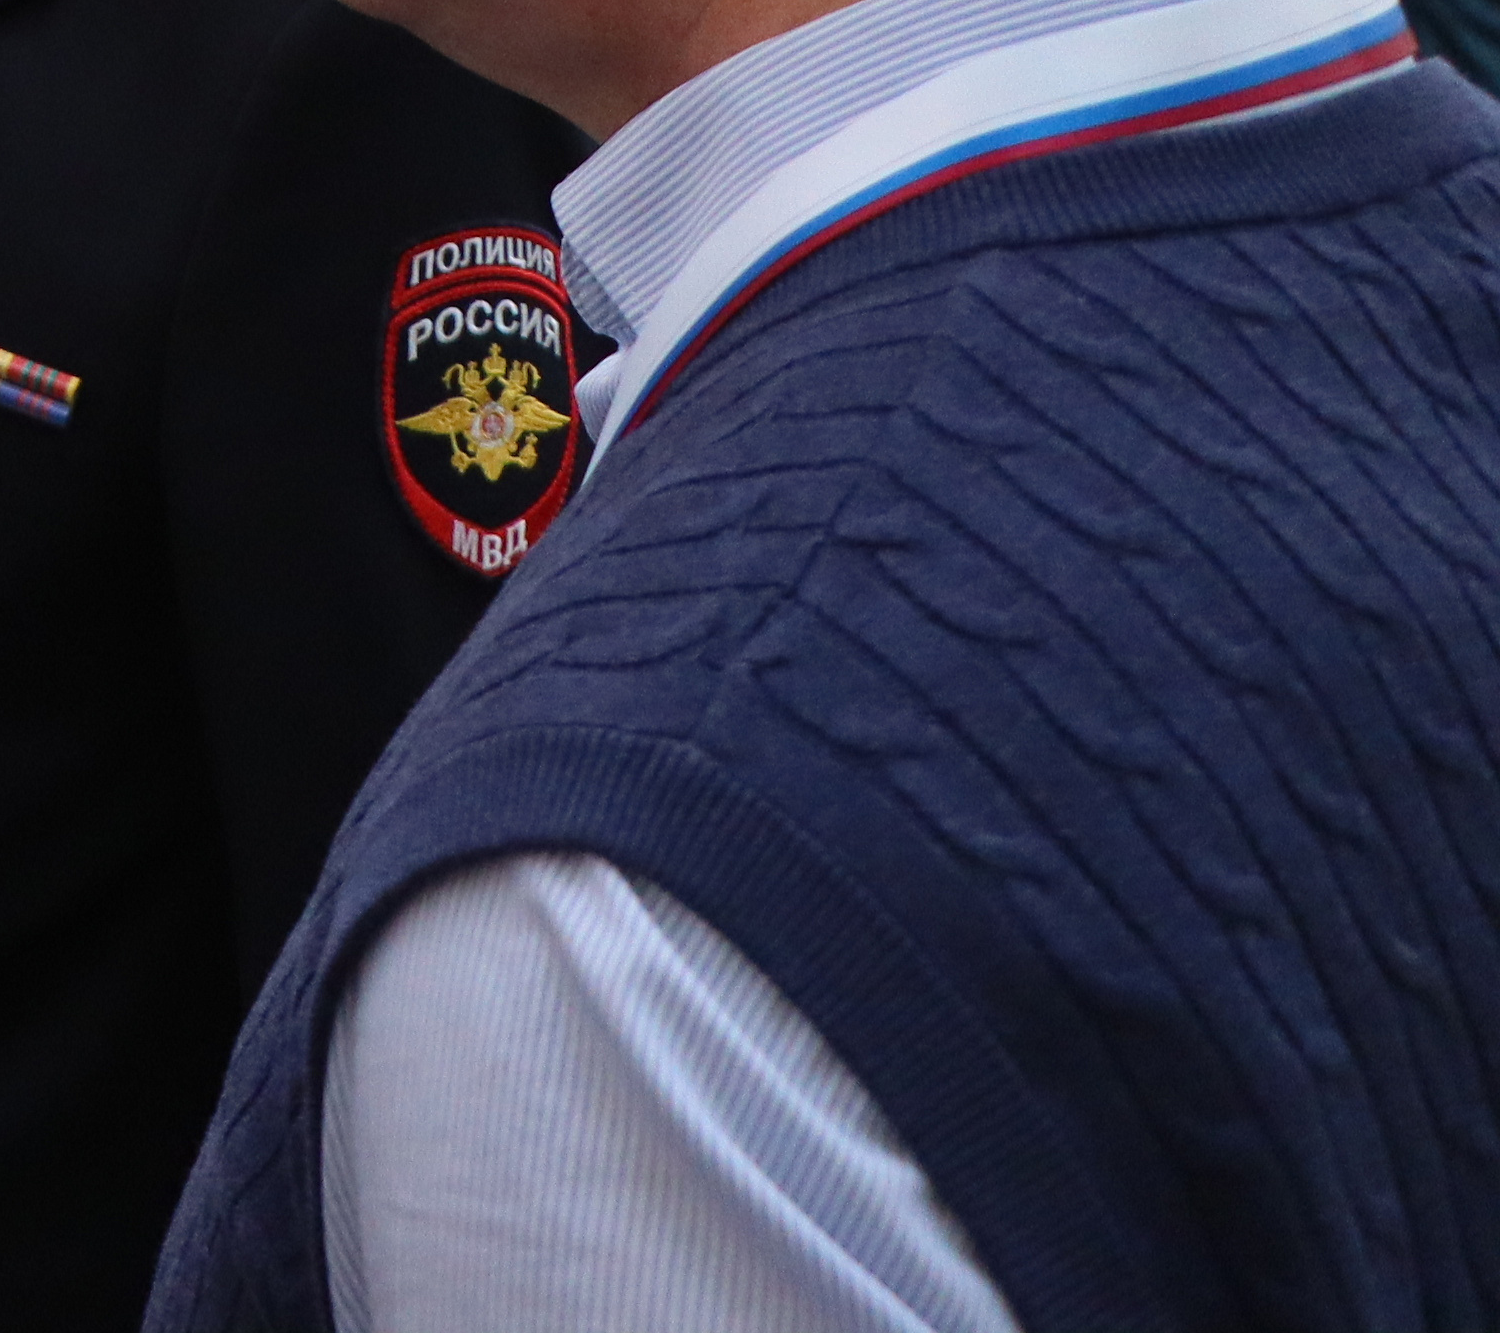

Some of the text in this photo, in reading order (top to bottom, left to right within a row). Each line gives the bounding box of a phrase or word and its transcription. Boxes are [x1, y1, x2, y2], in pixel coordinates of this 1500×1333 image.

[410, 236, 557, 287] ПОЛИЦИЯ
[408, 298, 562, 362] РОССИЯ
[452, 519, 529, 570] МВД
